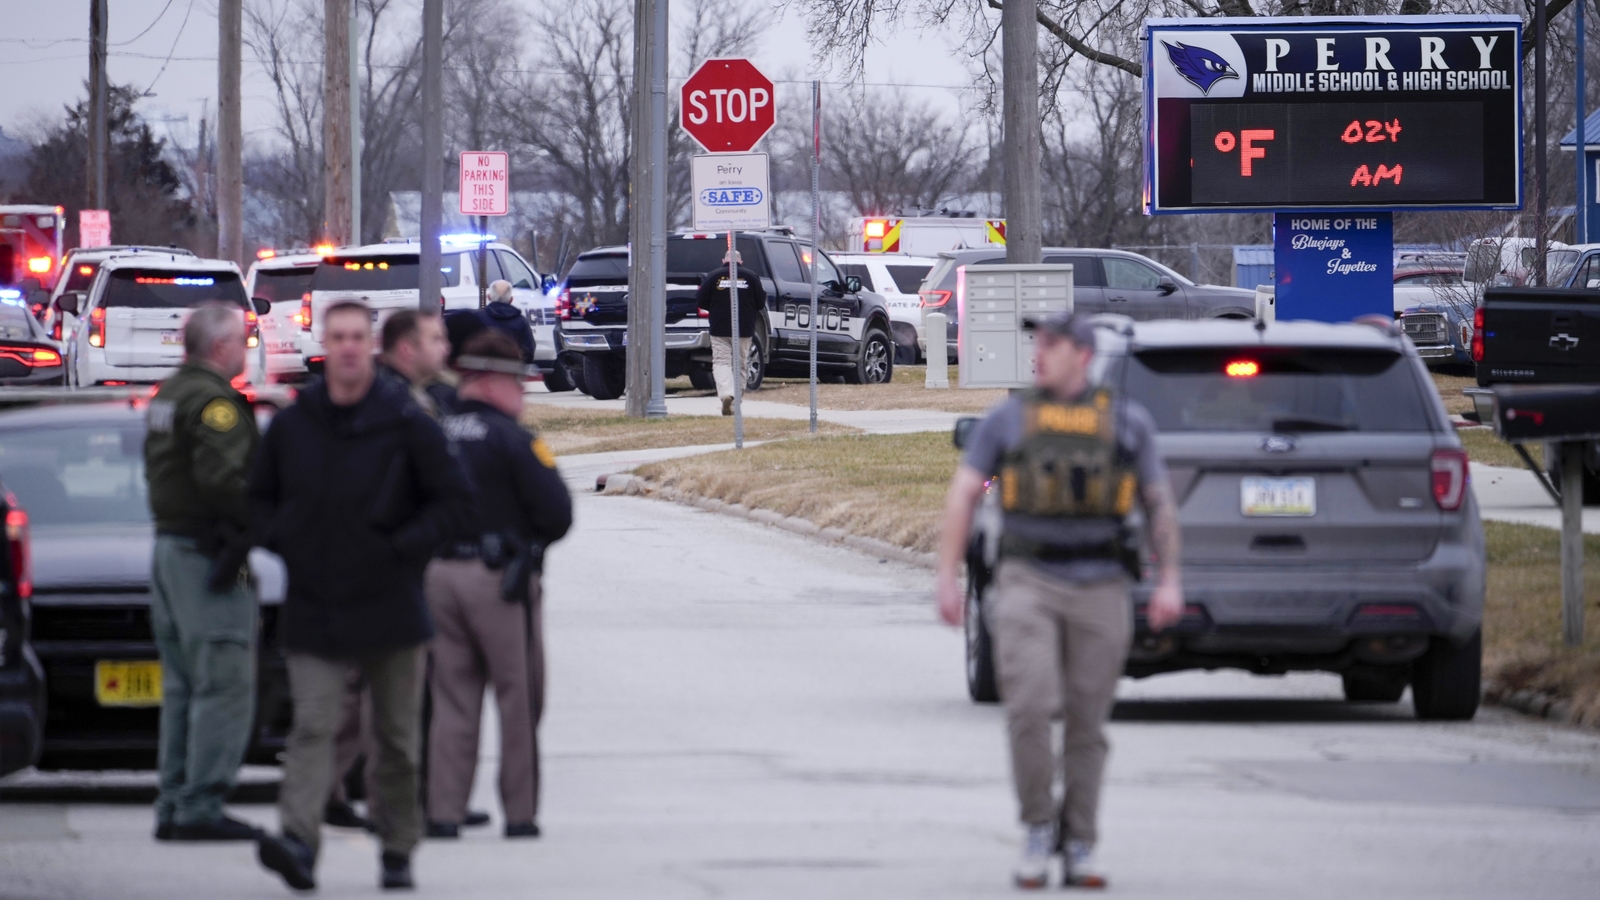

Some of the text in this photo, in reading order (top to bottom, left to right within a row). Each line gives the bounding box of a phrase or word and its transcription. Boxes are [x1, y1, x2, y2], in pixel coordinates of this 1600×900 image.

[1265, 36, 1499, 72] PERRY
[1253, 70, 1511, 93] MIDDLE SCHOOL & HIGH SCHOOL
[689, 87, 769, 125] STOP
[1341, 118, 1402, 144] 024
[478, 155, 490, 167] NO
[464, 170, 504, 181] PARKING
[717, 165, 743, 175] Perry
[1350, 164, 1403, 187] AM
[473, 184, 494, 196] THIS
[708, 190, 754, 203] SAFE
[472, 198, 494, 211] SIDE
[1291, 218, 1377, 230] HOME OF THE
[1291, 234, 1345, 251] Bluejays
[1341, 248, 1352, 259] &
[1326, 258, 1377, 275] Jayettes
